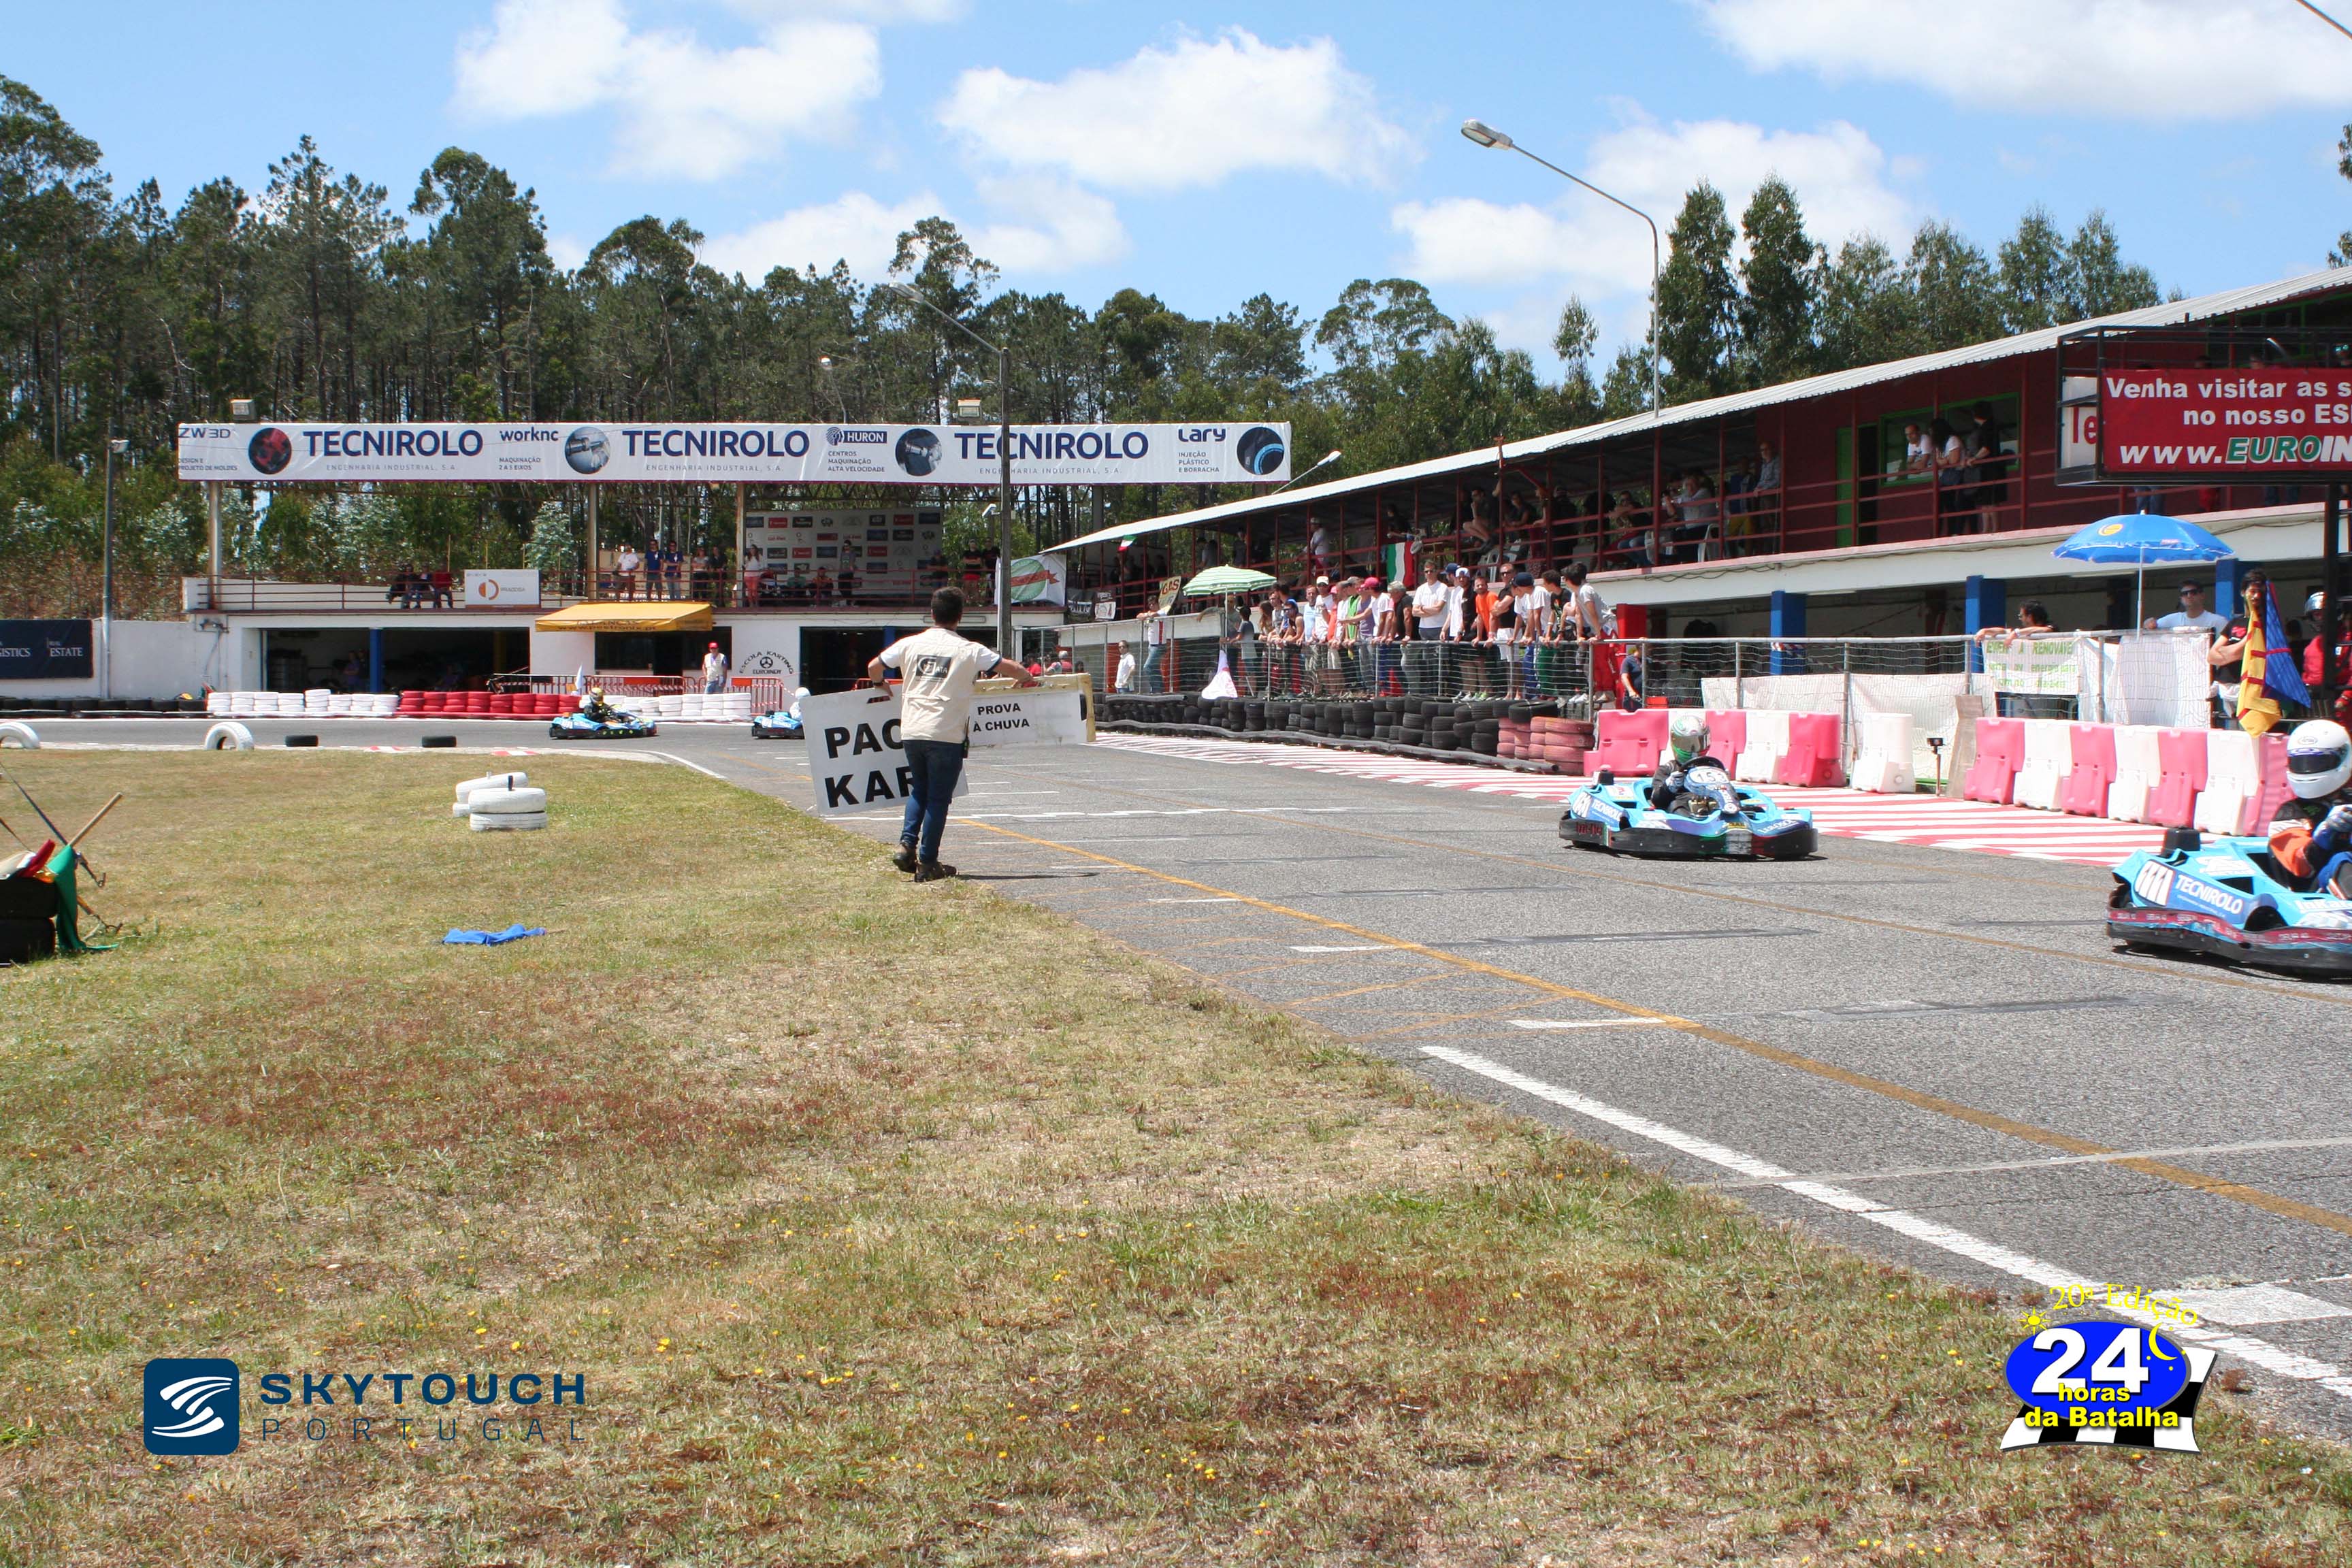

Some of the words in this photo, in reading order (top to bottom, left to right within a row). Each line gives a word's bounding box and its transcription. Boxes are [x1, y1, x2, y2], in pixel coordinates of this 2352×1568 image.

[2106, 377, 2188, 399] Venha
[2198, 378, 2287, 399] visitar
[2297, 381, 2328, 397] as
[2183, 410, 2216, 425] no
[2225, 408, 2306, 425] nosso
[2315, 404, 2352, 424] ES
[303, 429, 483, 457] TECNIROLO
[499, 426, 559, 442] worknc
[622, 429, 810, 457] TECNIROLO
[847, 431, 884, 442] HURON
[954, 431, 1149, 460] TECNIROLO
[50, 647, 83, 657] ESTATE
[739, 651, 763, 674] ESCOLA
[766, 651, 794, 674] KARTING
[977, 702, 1022, 716] PROVA
[973, 721, 982, 732] À
[985, 718, 1030, 731] CHUVA
[2175, 874, 2244, 915] TECNIROLO
